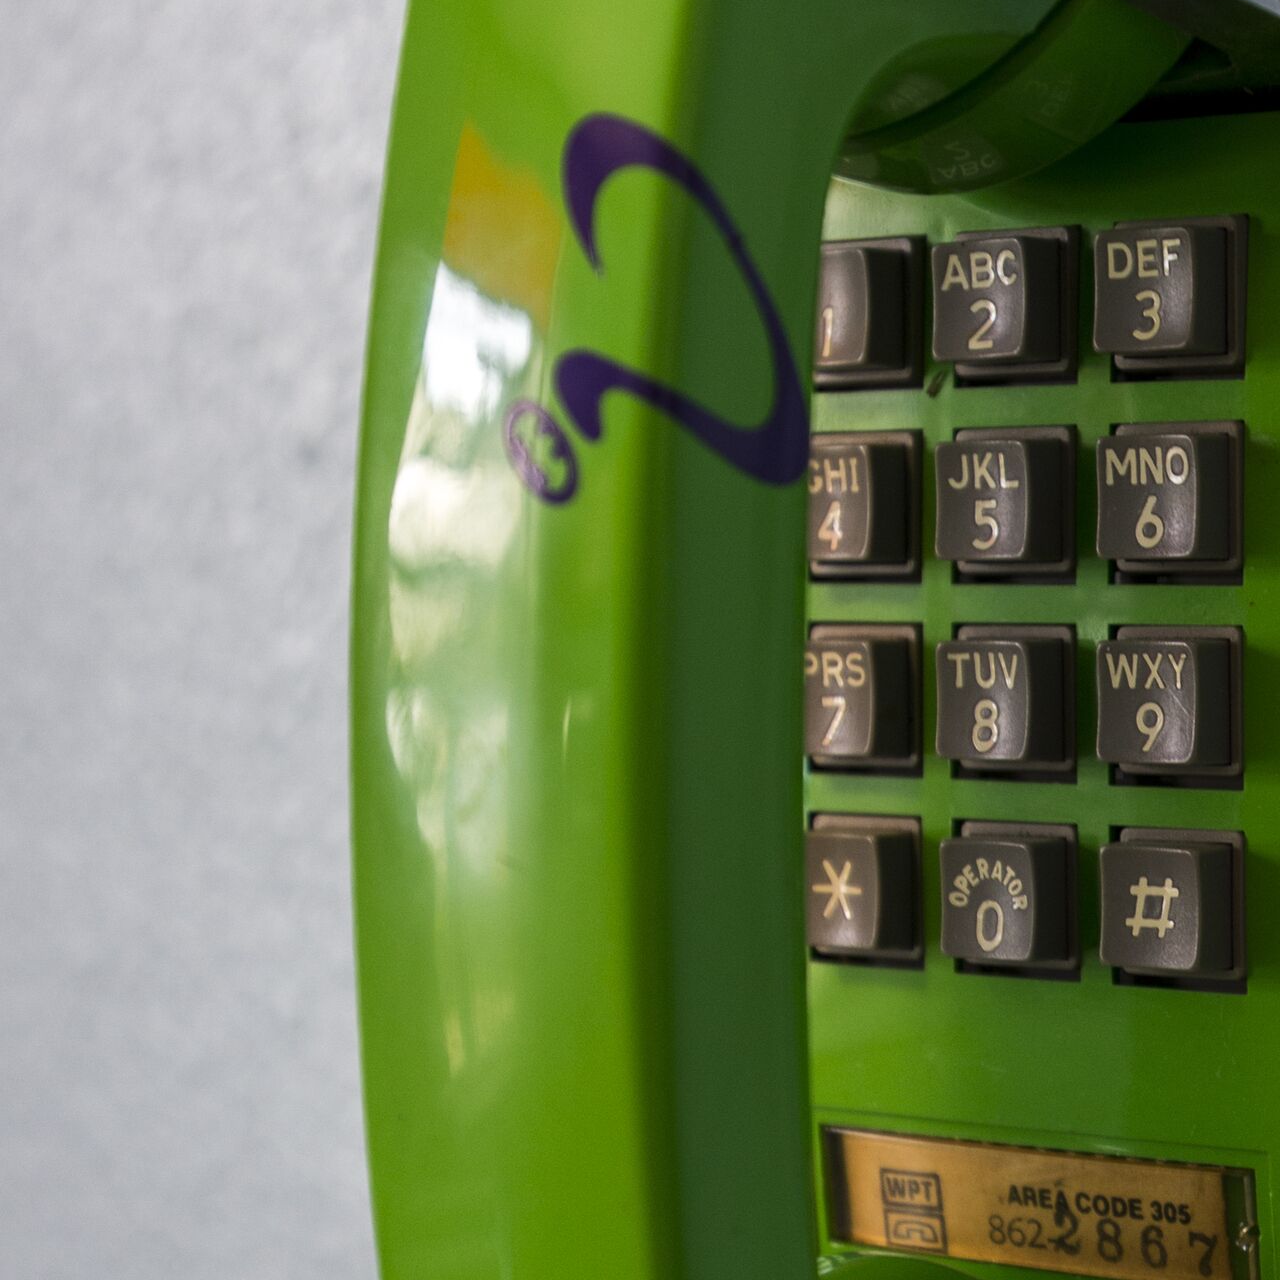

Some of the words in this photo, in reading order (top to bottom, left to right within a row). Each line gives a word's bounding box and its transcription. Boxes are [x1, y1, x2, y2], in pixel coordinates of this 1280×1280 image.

[942, 250, 1017, 291] ABC
[1106, 238, 1180, 280] DEF
[822, 307, 834, 357] 1
[968, 299, 996, 350] 2
[1133, 290, 1162, 341] 3
[948, 452, 1019, 490] JKL
[1105, 446, 1189, 486] MNO
[818, 501, 844, 551] 4
[972, 500, 998, 550] 5
[1135, 495, 1164, 549] 6
[947, 652, 1017, 690] TUV
[1106, 652, 1187, 690] WXY
[821, 696, 846, 746] 7
[972, 699, 998, 753] 8
[1136, 702, 1164, 752] 9
[949, 857, 1029, 910] OPERATOR
[976, 900, 1004, 952] 0
[885, 1177, 934, 1204] WPT
[1008, 1184, 1070, 1214] AREA
[1075, 1192, 1144, 1220] CODE
[1150, 1200, 1192, 1226] 305
